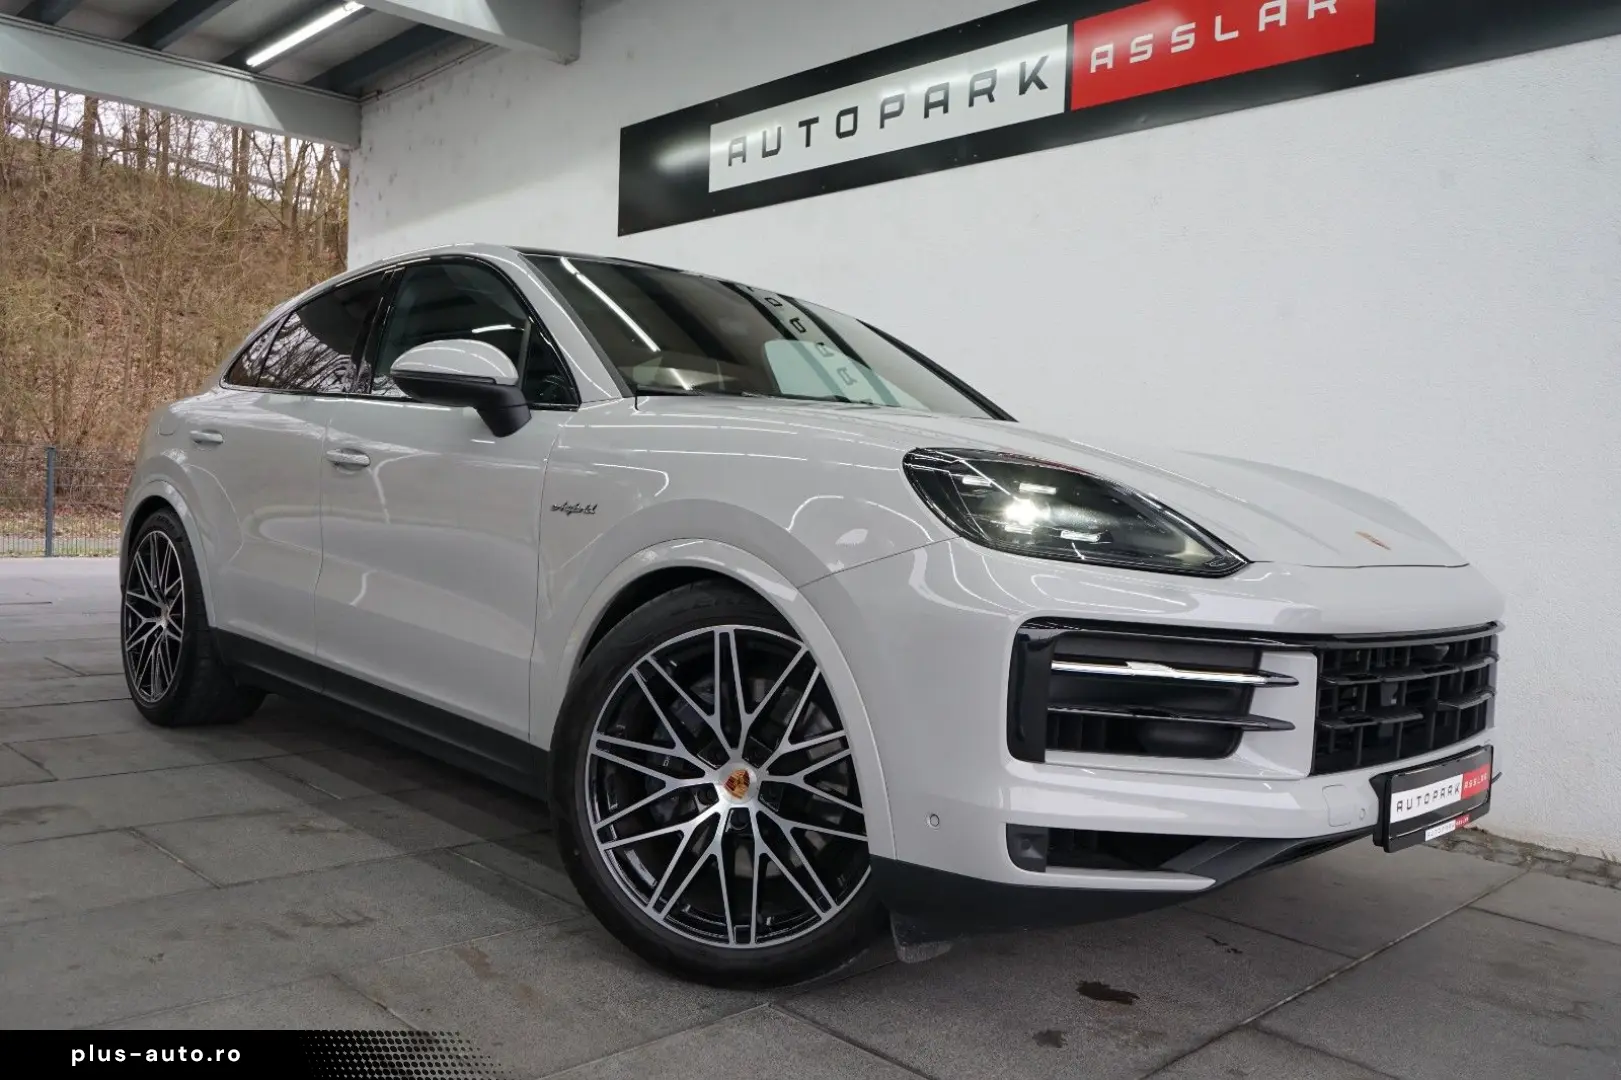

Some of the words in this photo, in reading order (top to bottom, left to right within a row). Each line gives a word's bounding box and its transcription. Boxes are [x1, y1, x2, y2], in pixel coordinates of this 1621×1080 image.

[728, 56, 1049, 167] AUTOPARK
[1090, 0, 1337, 73] ASSLAR
[1396, 782, 1461, 813] AUTOPARK
